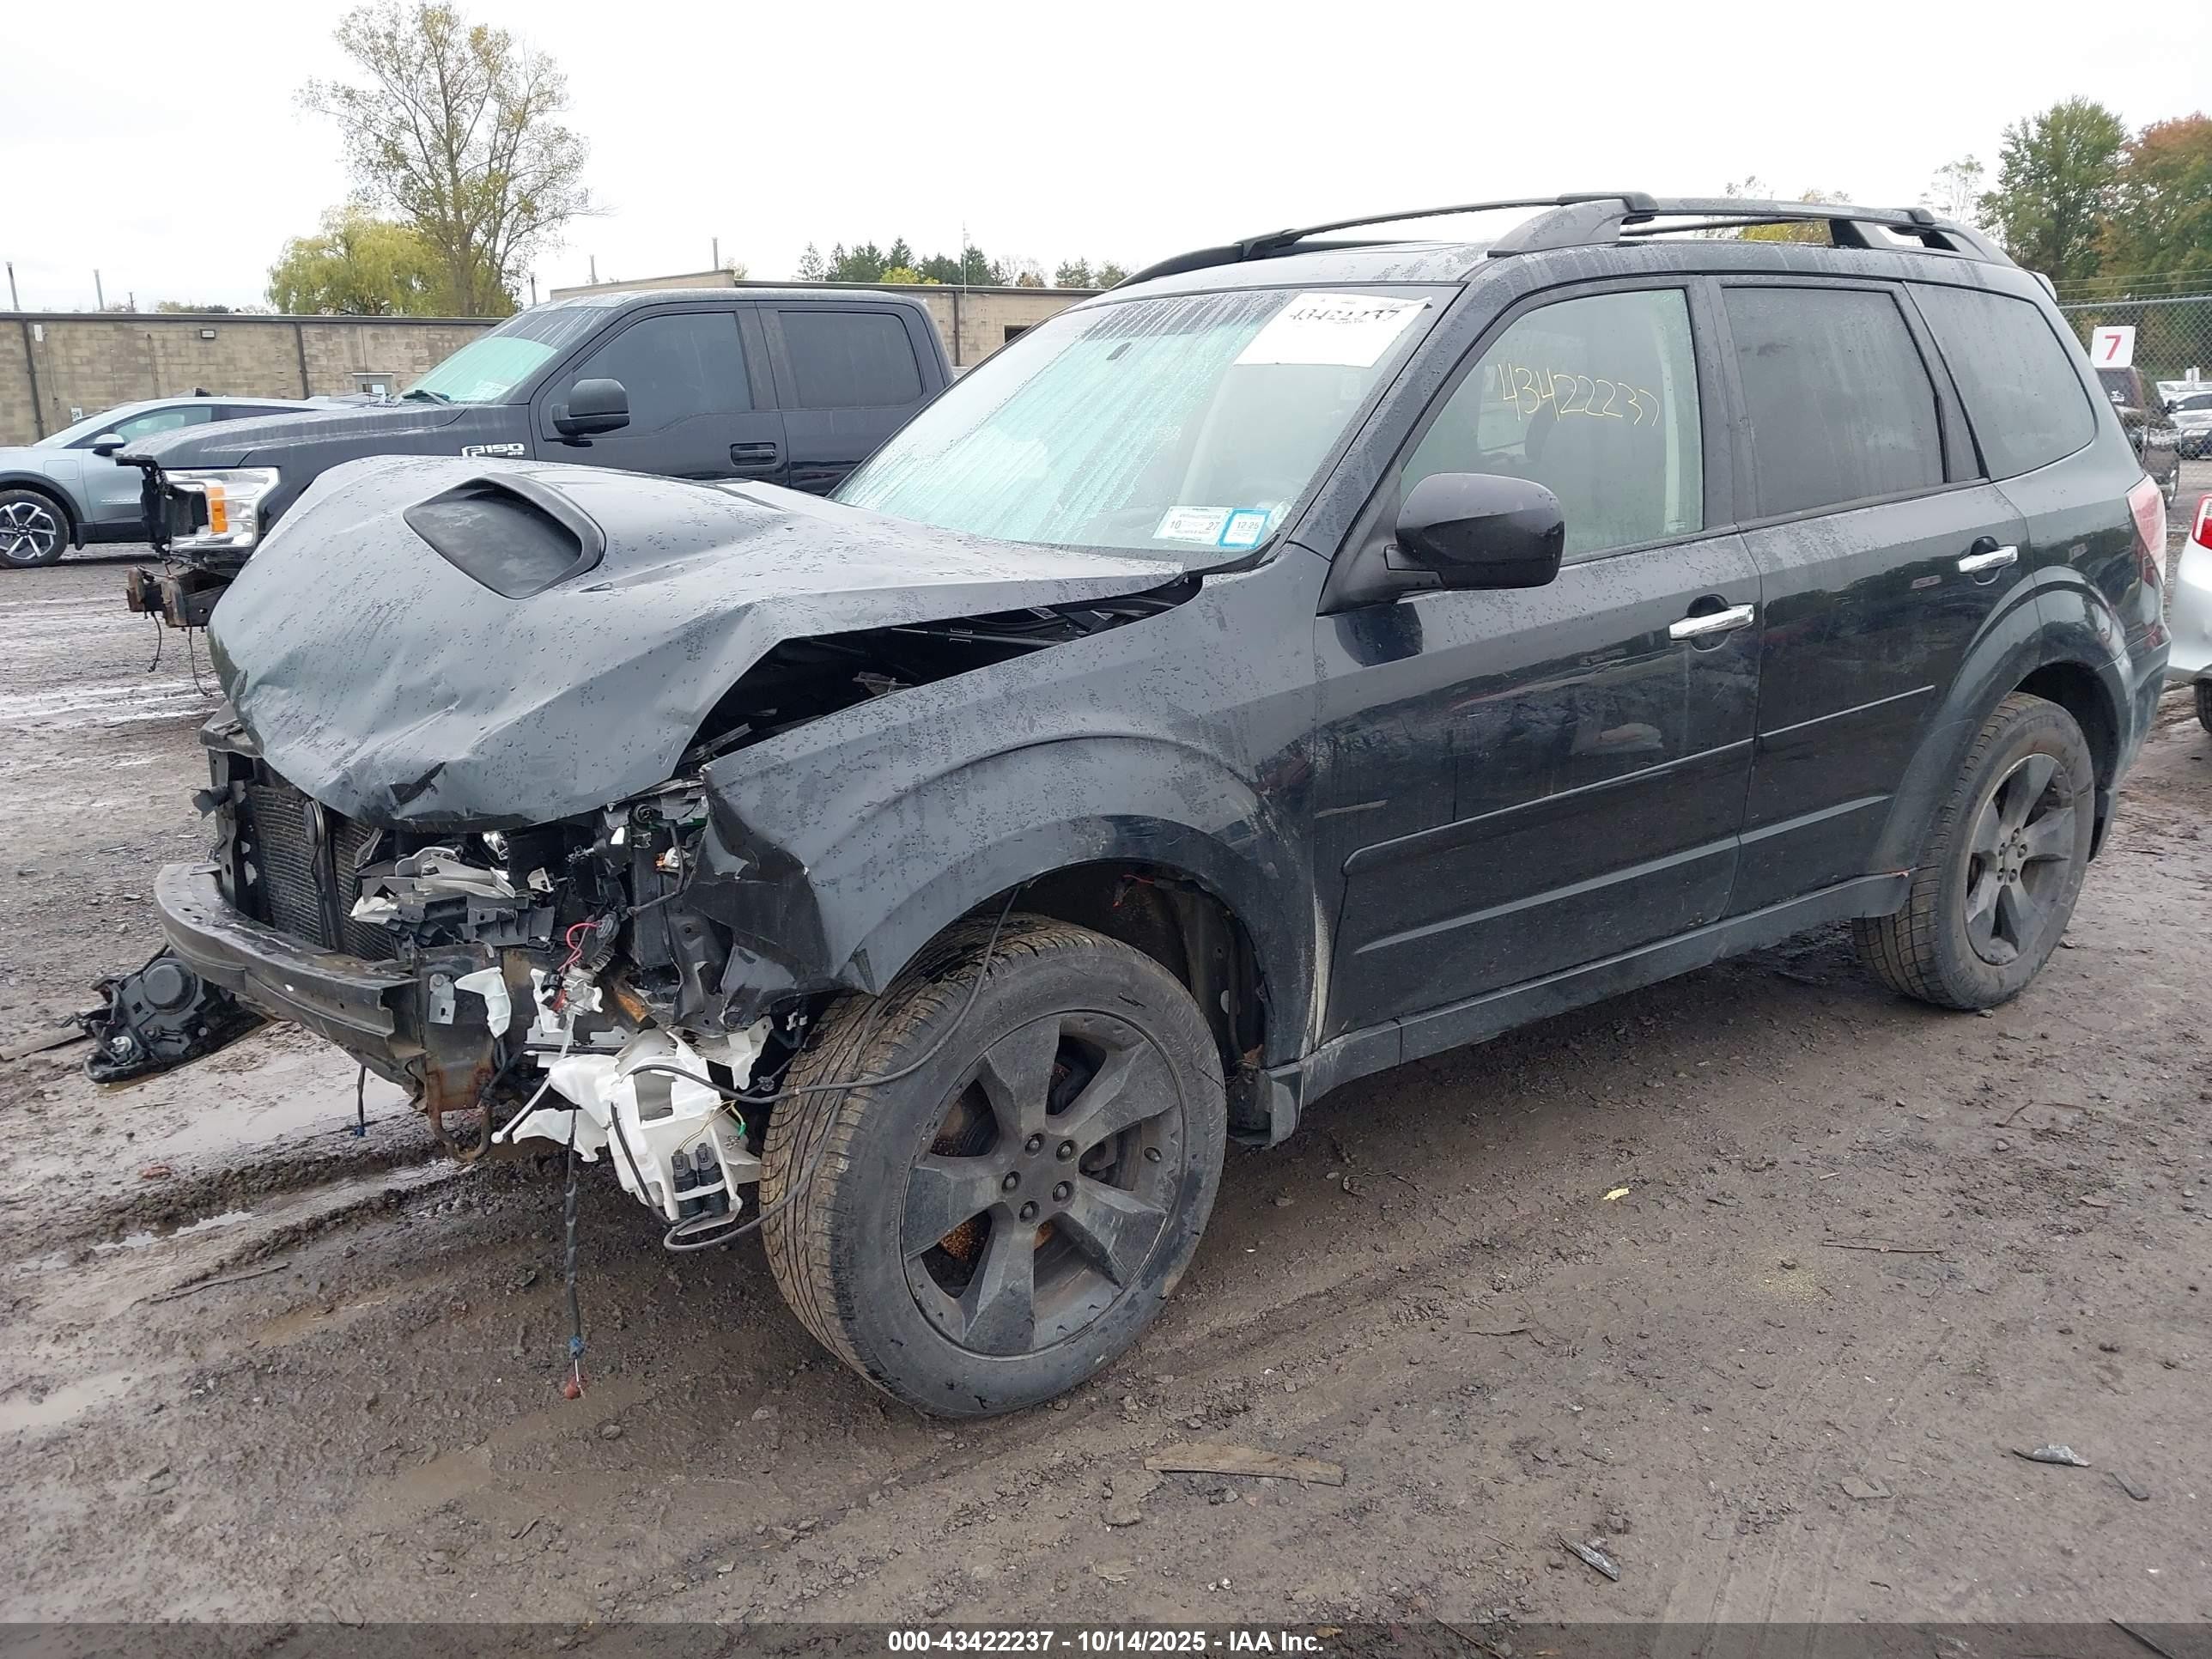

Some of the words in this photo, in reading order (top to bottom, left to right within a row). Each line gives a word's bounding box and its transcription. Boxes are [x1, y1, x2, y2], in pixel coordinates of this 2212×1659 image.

[2104, 334, 2123, 361] 7
[1497, 362, 1661, 428] 43422237
[1205, 521, 1221, 531] 27
